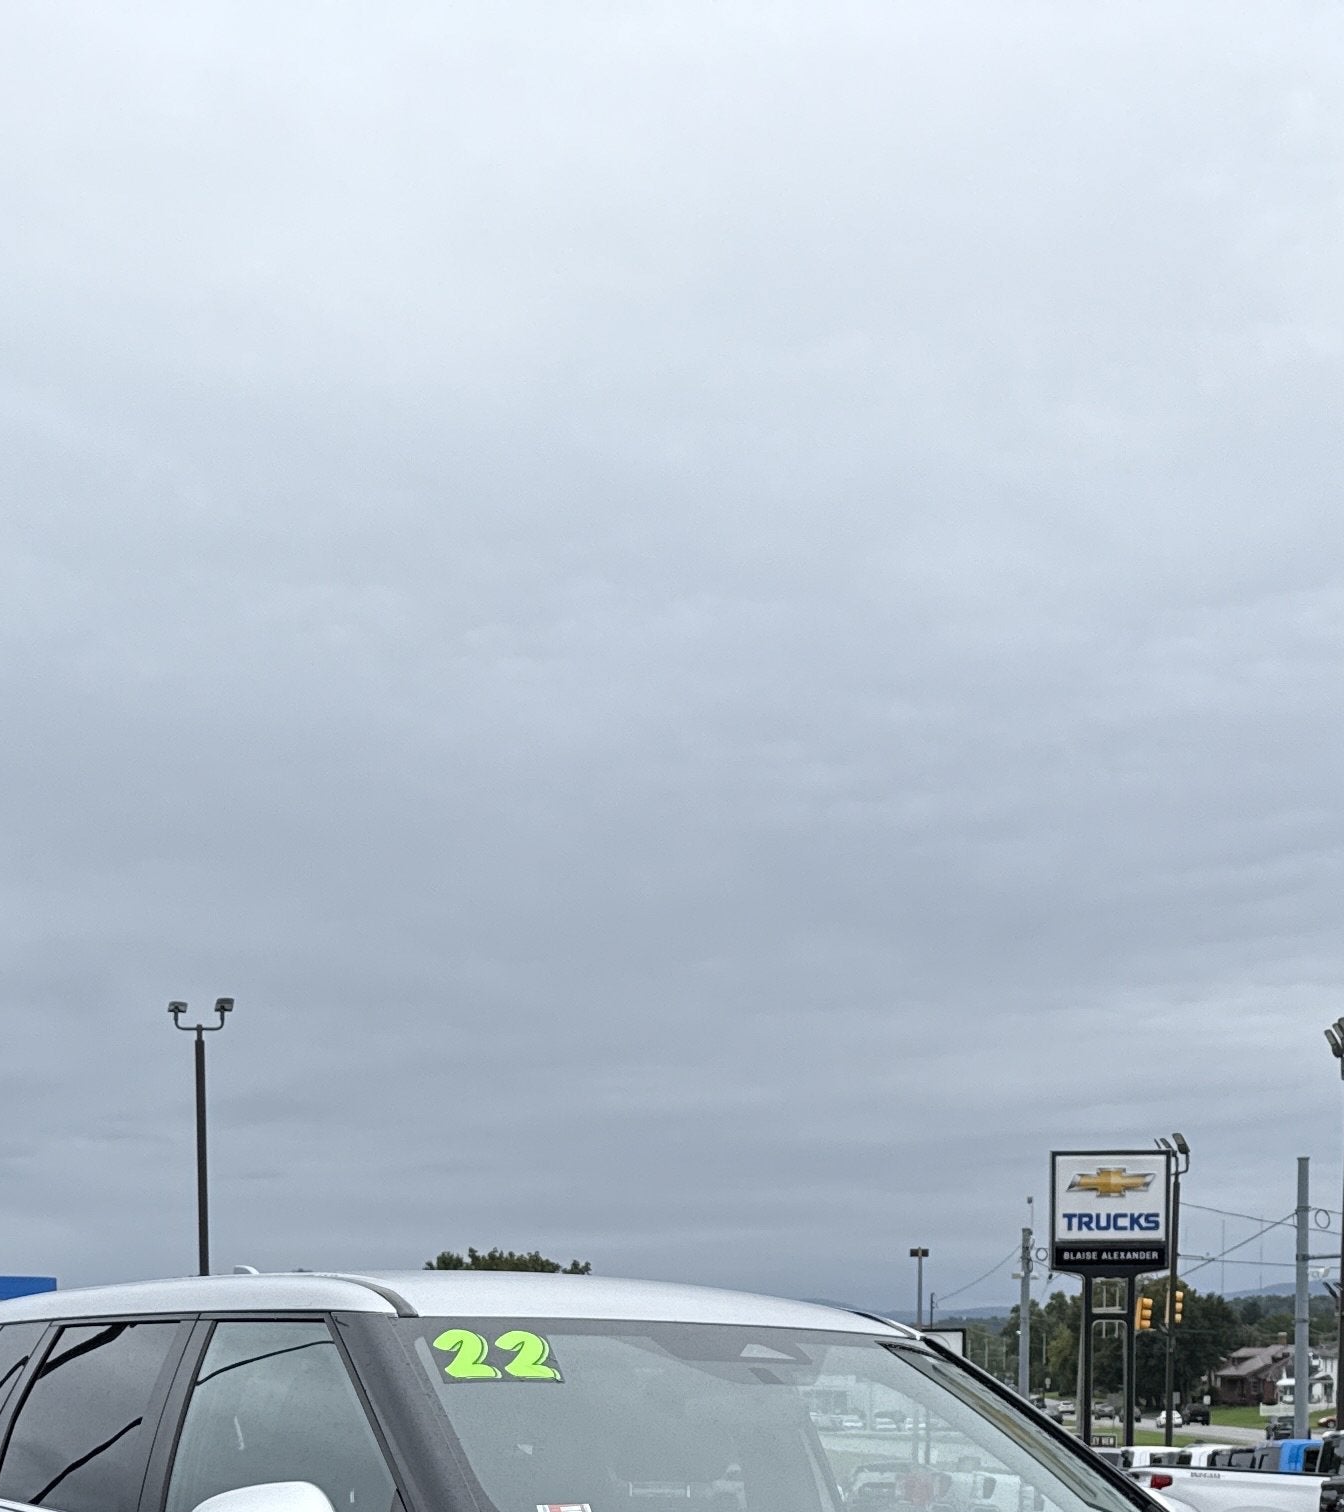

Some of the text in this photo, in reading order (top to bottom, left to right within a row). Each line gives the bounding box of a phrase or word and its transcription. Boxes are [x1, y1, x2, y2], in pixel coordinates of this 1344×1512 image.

[1062, 1212, 1160, 1231] TRUCKS
[1063, 1250, 1159, 1260] BLAISE ALEXANDER
[433, 1329, 562, 1381] 22
